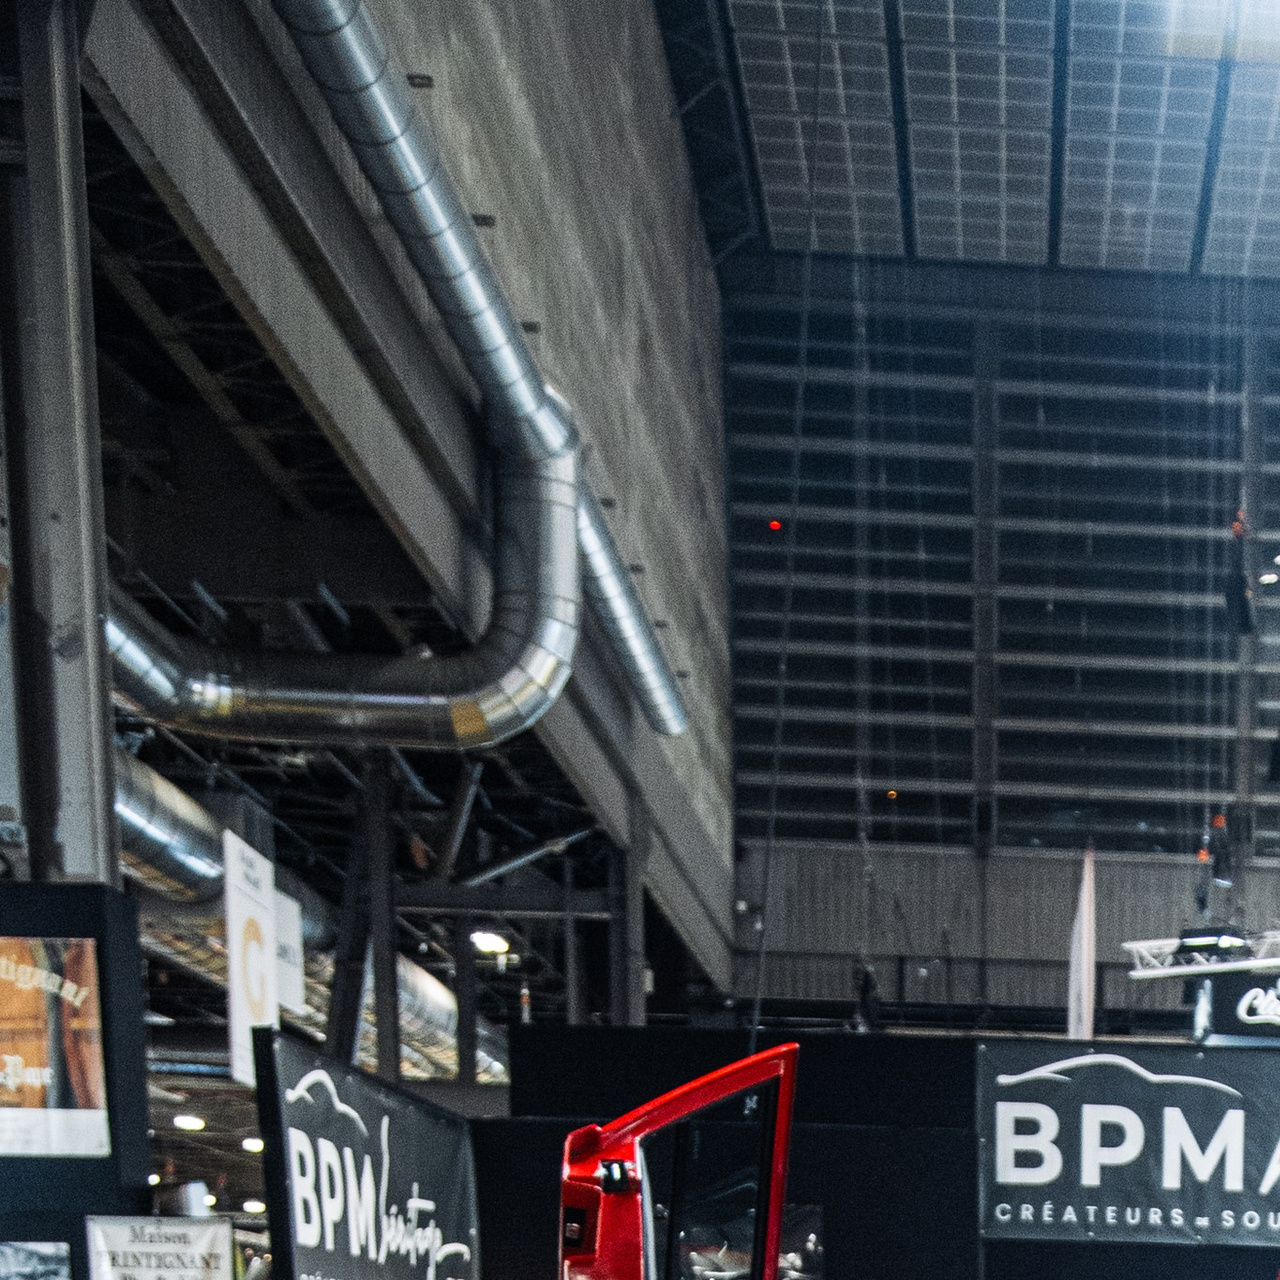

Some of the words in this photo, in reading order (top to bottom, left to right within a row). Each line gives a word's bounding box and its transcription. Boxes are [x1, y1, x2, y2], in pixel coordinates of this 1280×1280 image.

[995, 1100, 1246, 1192] BPM
[288, 1126, 378, 1262] BPM
[995, 1201, 1184, 1227] CRÉATEURS
[129, 1225, 192, 1243] Maison
[108, 1250, 221, 1270] RINTIGNANT
